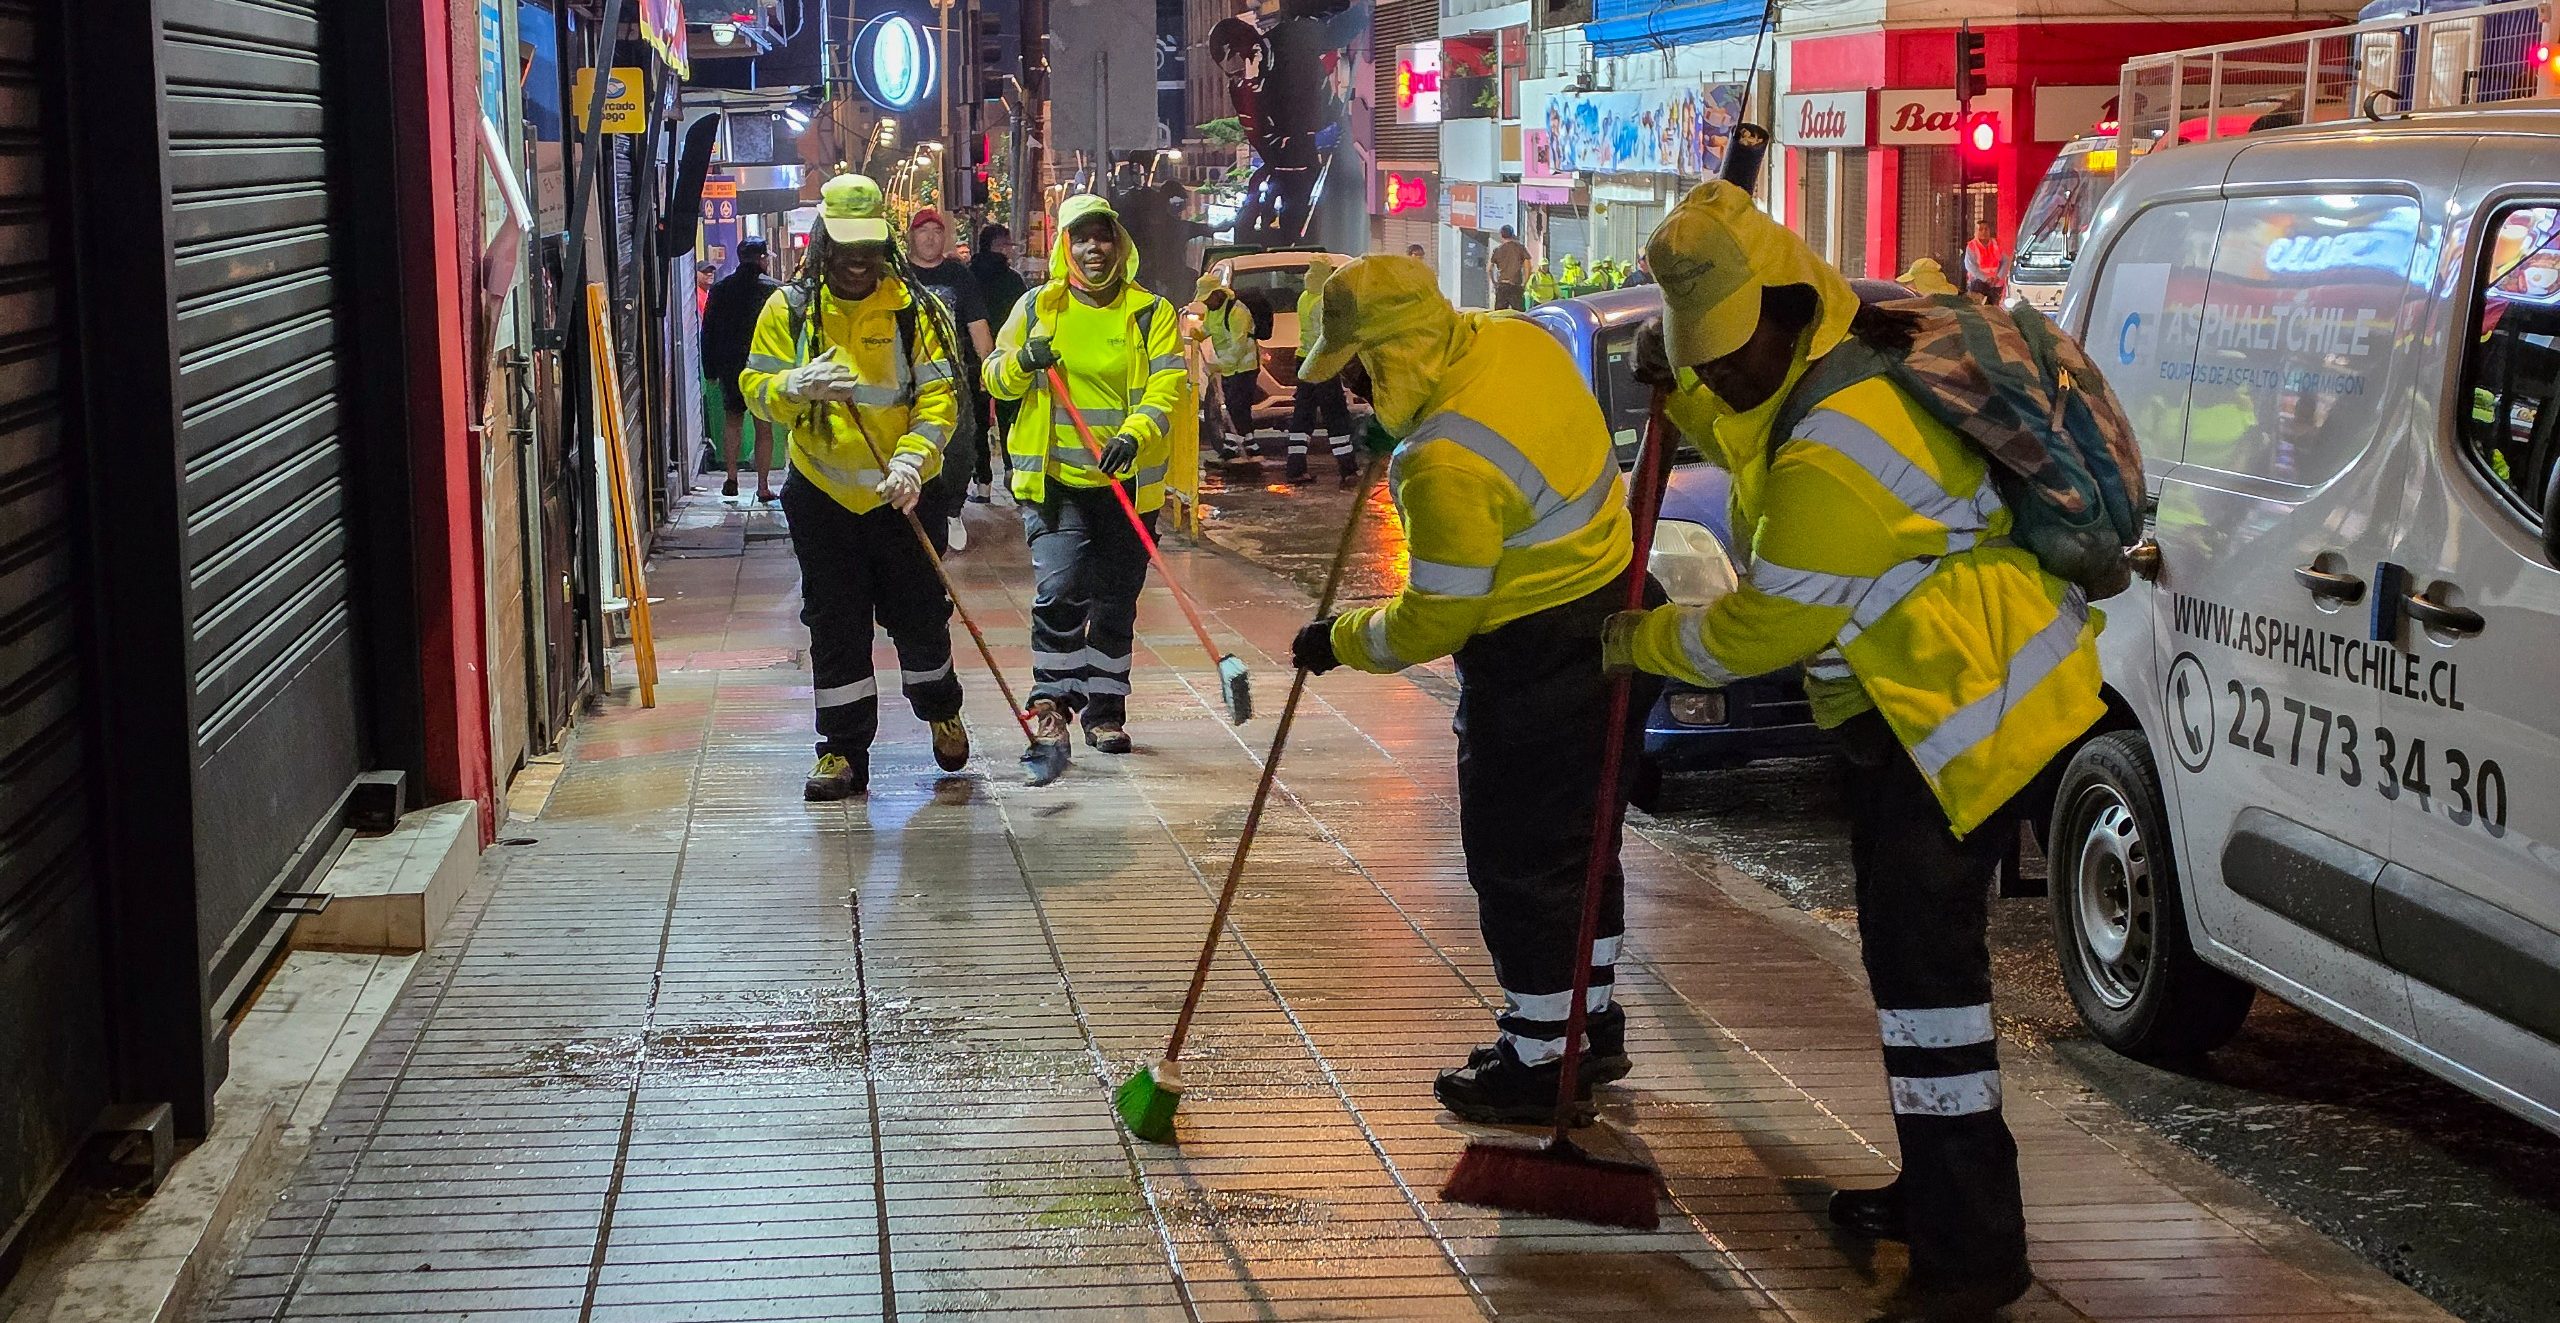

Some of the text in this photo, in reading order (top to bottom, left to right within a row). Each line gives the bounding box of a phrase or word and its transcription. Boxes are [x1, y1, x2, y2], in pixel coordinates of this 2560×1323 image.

[1798, 98, 1847, 140] Bata
[2166, 302, 2376, 356] ASPHALTCHILE
[2160, 360, 2206, 383] EQUIPOS
[2209, 365, 2225, 385] DE
[2226, 366, 2278, 389] ASFALTO
[2173, 592, 2465, 712] WWW.ASPHALTCHILE.CL
[2227, 678, 2507, 839] 22 773 34 30
